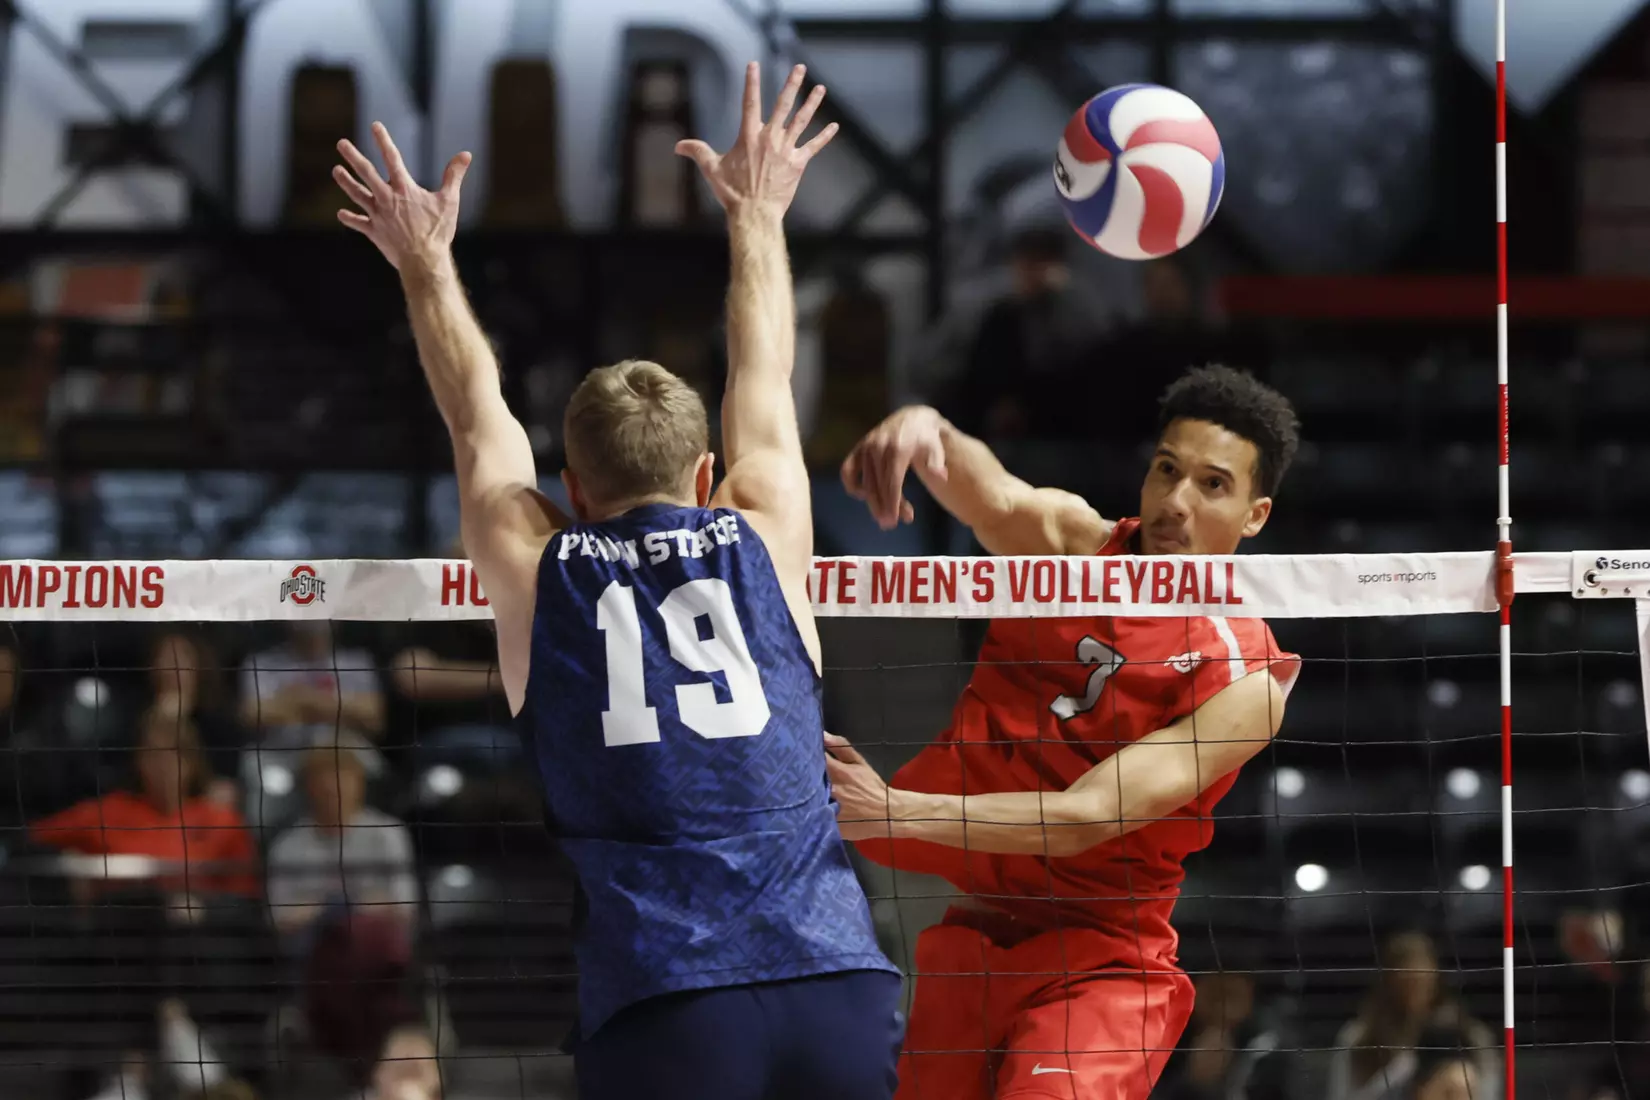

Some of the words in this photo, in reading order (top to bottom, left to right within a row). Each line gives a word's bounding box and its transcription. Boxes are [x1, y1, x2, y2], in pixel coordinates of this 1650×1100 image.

[558, 532, 640, 570] PENN
[644, 515, 741, 566] STATE
[1611, 558, 1650, 570] Seno
[0, 564, 165, 608] MPIONS
[806, 561, 857, 604] TE
[871, 560, 995, 604] MEN'S
[1008, 559, 1243, 605] VOLLEYBALL
[597, 578, 771, 747] 19
[1048, 634, 1127, 721] 7
